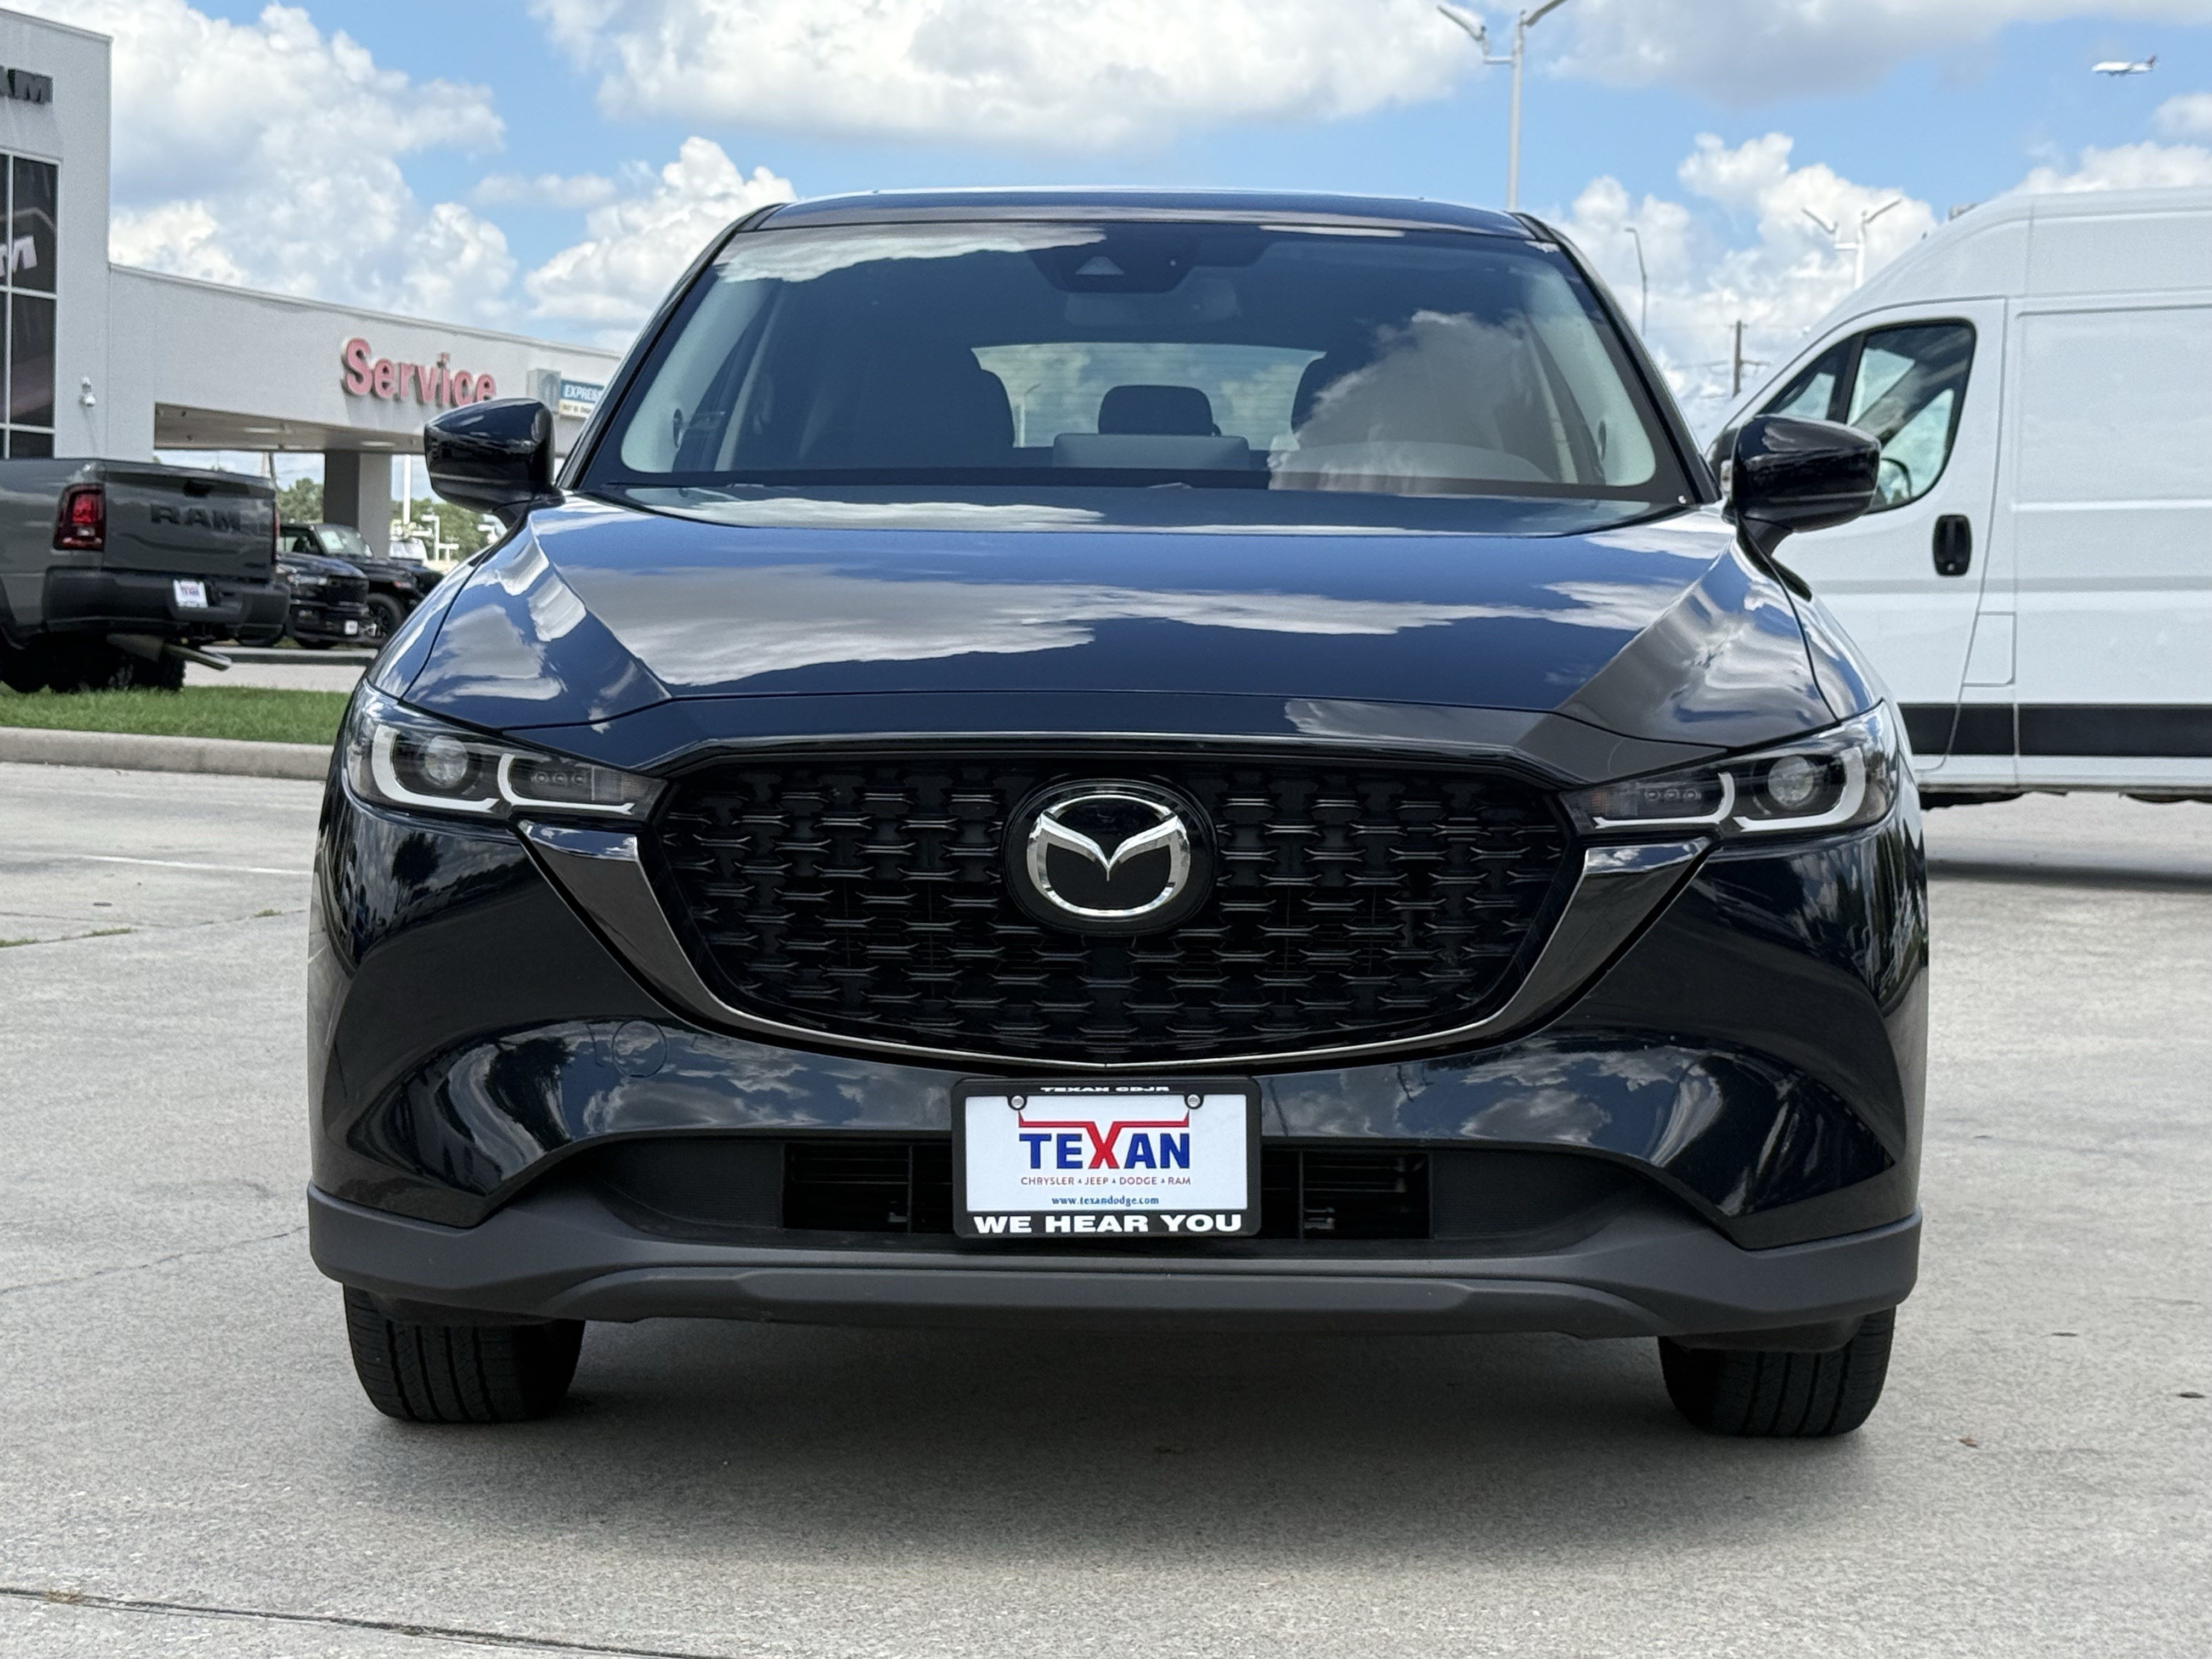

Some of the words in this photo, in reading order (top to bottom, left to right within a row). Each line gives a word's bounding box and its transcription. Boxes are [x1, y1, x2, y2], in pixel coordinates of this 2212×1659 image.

[342, 337, 496, 406] Service
[150, 504, 240, 533] RAM
[1019, 1121, 1189, 1169] TEXAN
[1020, 1176, 1074, 1186] CHRYSLER
[1084, 1176, 1109, 1186] JEEP
[1119, 1176, 1158, 1186] DODGE
[1168, 1176, 1191, 1186] RAM
[1051, 1195, 1159, 1207] www.texandodge.com
[974, 1215, 1031, 1233] WE
[1045, 1215, 1149, 1233] HEAR
[1160, 1214, 1242, 1232] YOU
